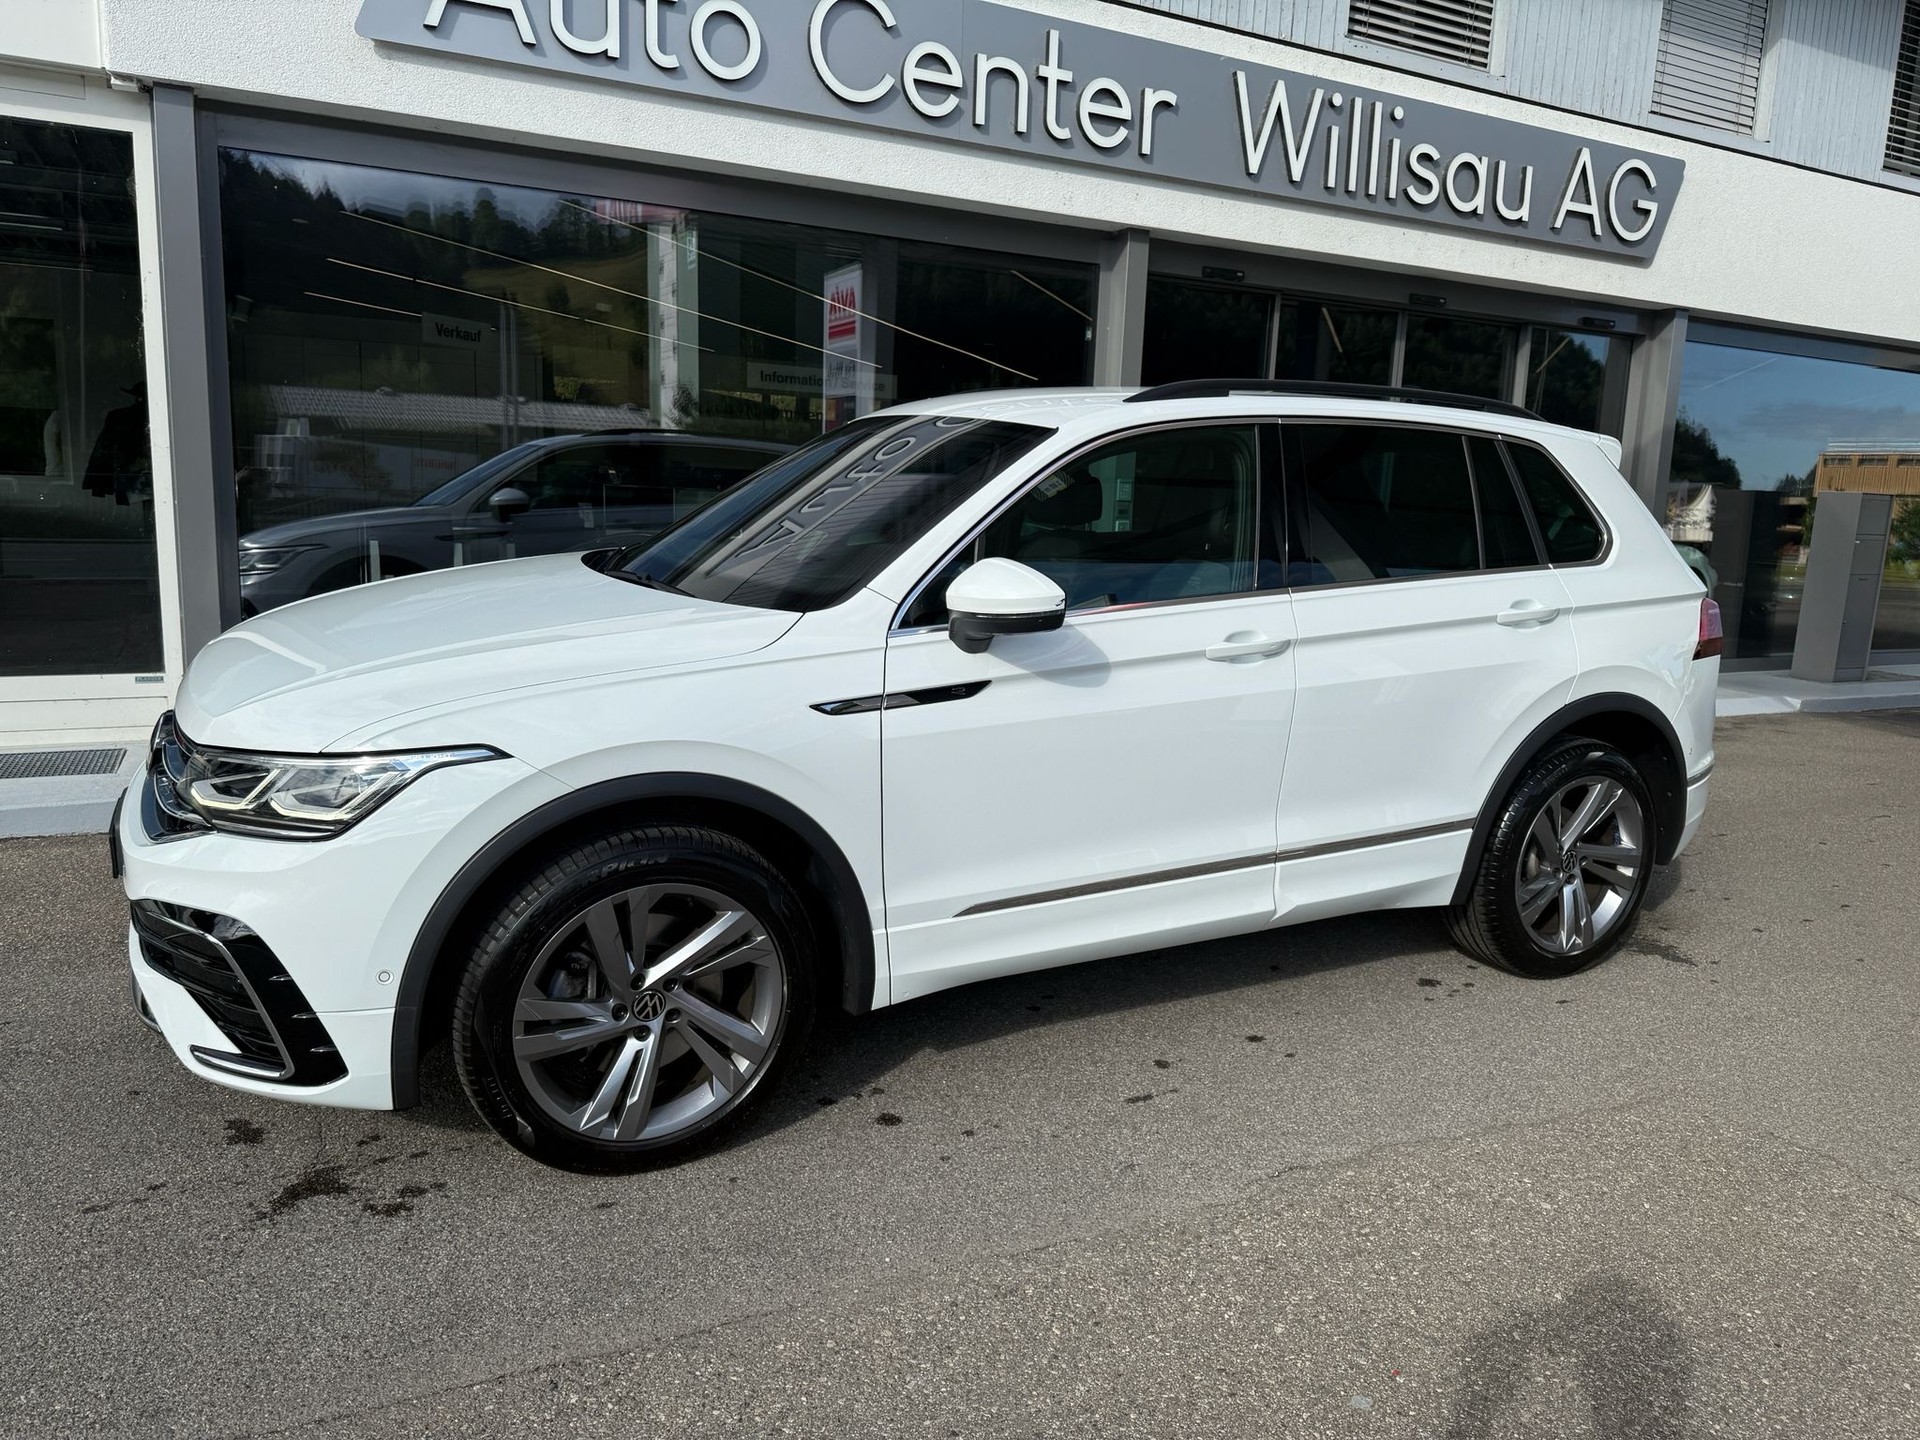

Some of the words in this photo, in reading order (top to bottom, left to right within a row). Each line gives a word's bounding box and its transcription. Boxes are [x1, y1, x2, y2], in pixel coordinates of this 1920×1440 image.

[808, 0, 1177, 156] Center
[1233, 70, 1533, 223] Willisau
[1551, 147, 1659, 242] AG
[435, 322, 482, 342] Verkauf
